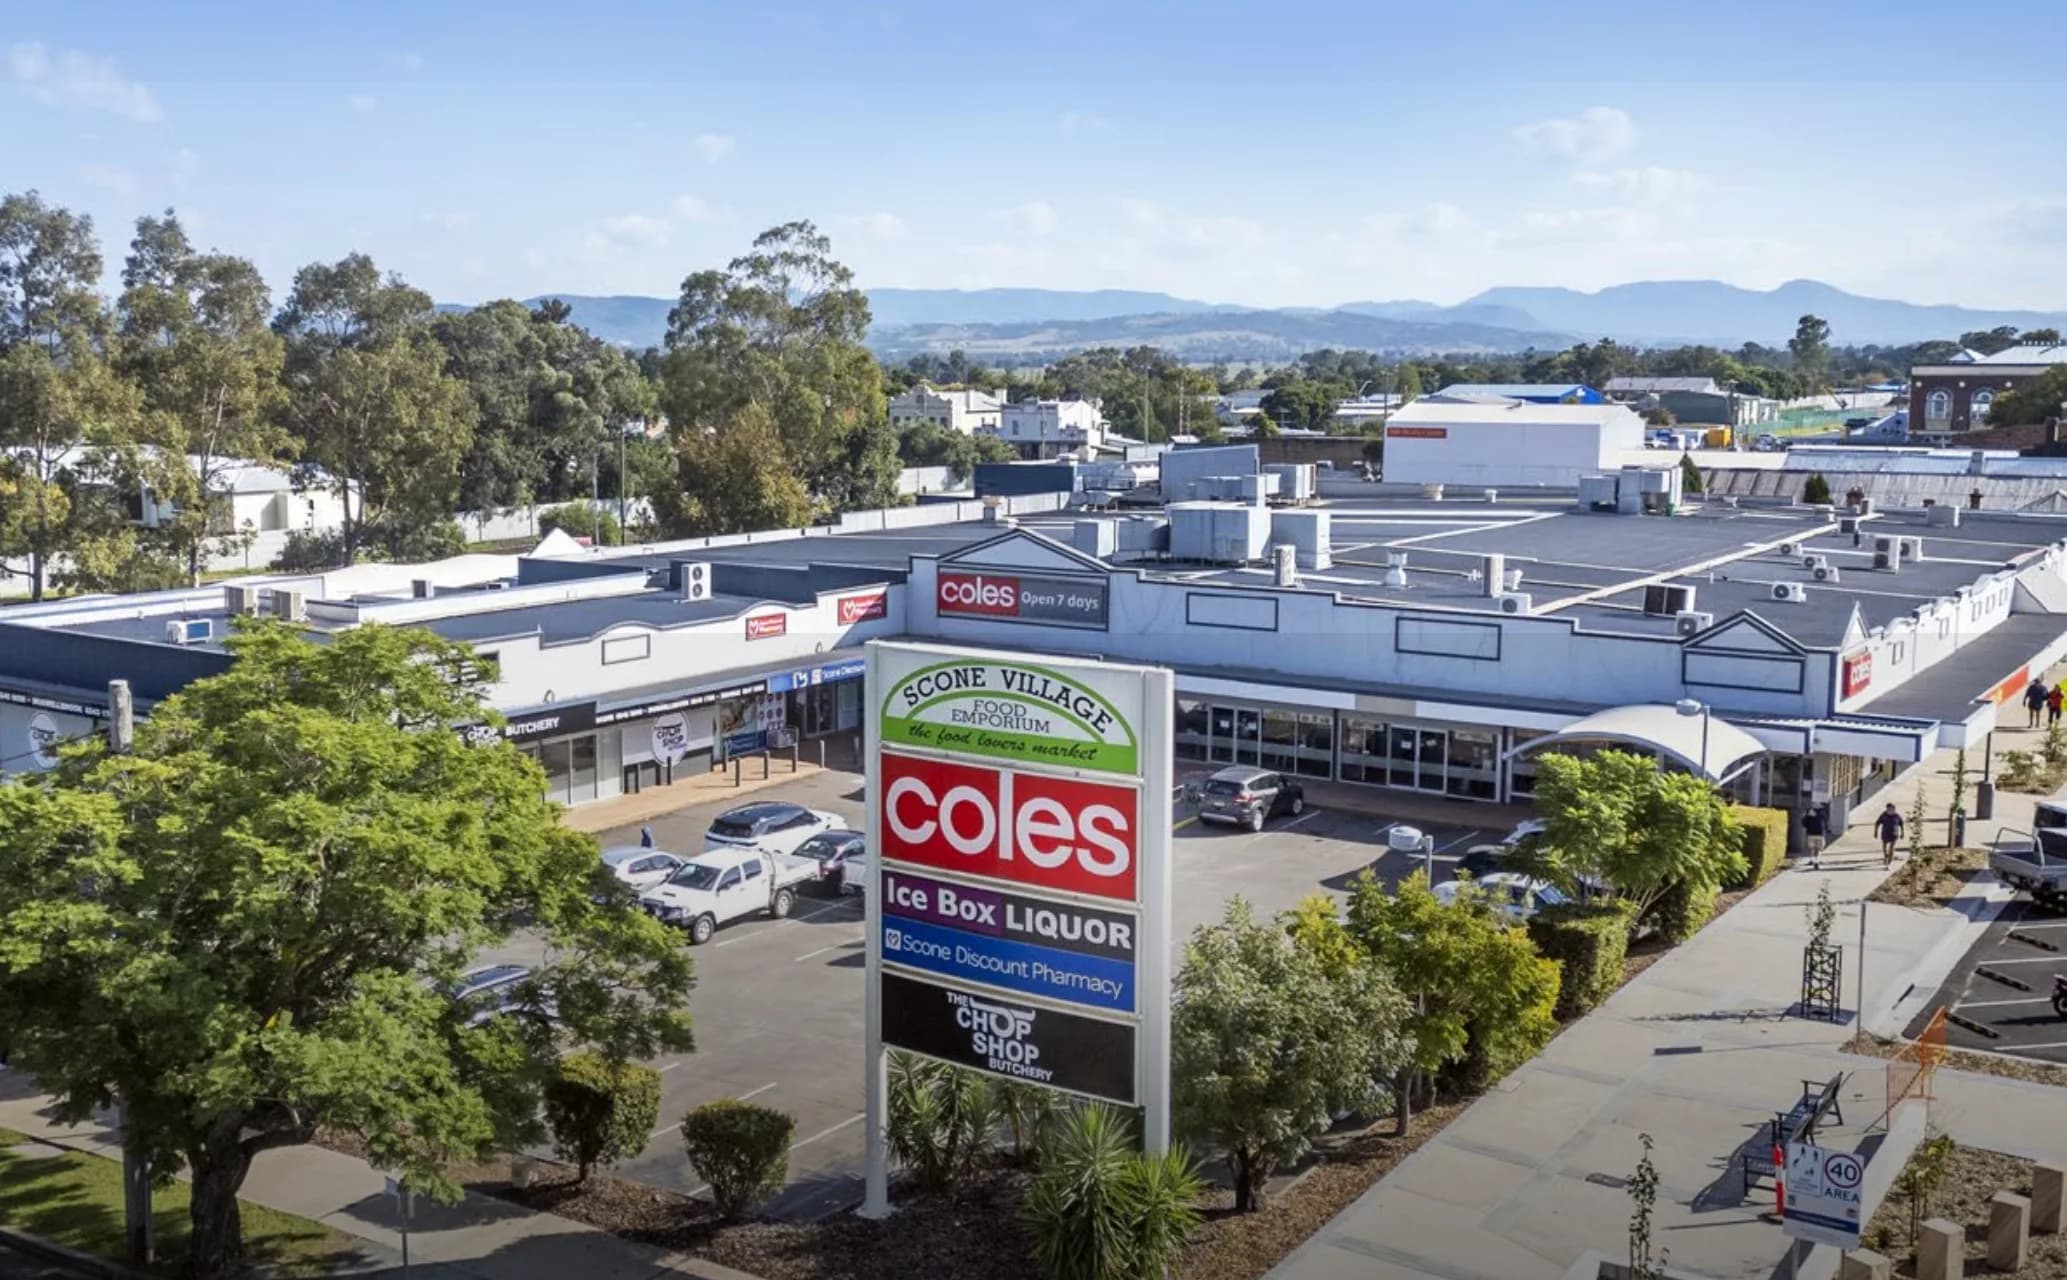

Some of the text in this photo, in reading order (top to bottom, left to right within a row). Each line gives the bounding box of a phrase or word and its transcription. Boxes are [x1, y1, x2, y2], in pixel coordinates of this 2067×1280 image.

[941, 576, 1015, 607] coles
[1021, 591, 1098, 611] Open 7 days
[903, 667, 1114, 733] SCONE VILLAGE
[974, 700, 1026, 717] FOOD
[505, 717, 559, 736] BUTCHERY
[951, 709, 1050, 733] EMPORIUM
[909, 723, 1098, 761] the food lovers market
[886, 770, 1130, 877] coles
[887, 877, 1132, 949] Ice Box LIQUOR
[902, 935, 1123, 1000] Scone Discount Pharmacy
[946, 991, 968, 1007] THE
[956, 1005, 1032, 1040] CHOP
[972, 1032, 1040, 1065] SHOP
[989, 1057, 1053, 1081] BUTCHERY
[1829, 1162, 1857, 1182] 40
[1824, 1187, 1860, 1204] AREA
